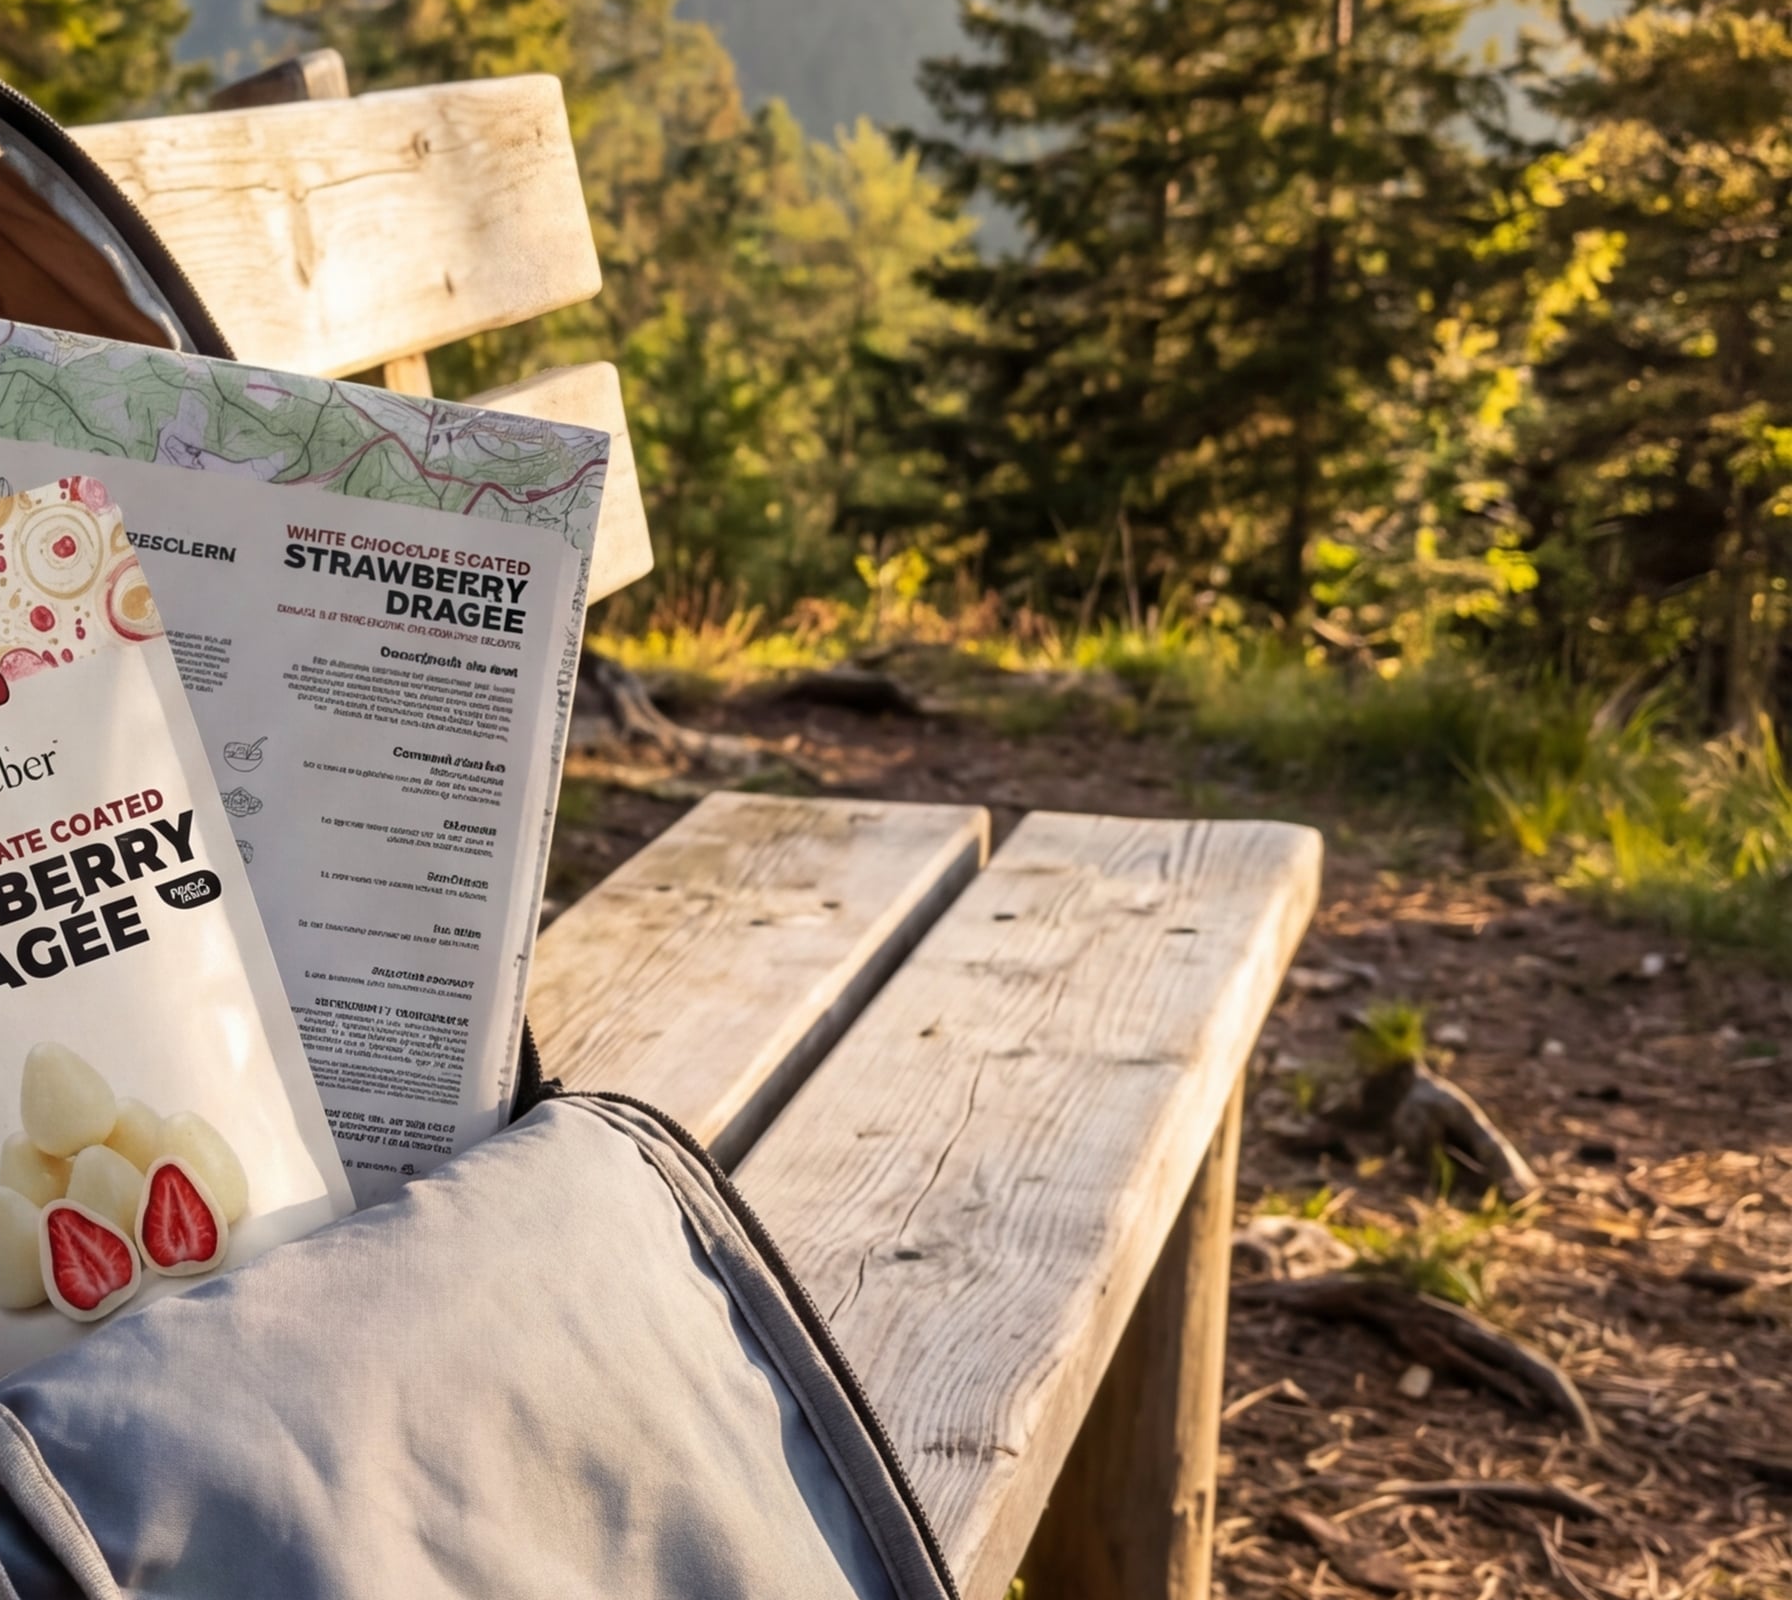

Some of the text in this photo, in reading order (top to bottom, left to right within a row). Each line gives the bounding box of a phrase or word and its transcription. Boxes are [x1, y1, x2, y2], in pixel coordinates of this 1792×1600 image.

[283, 543, 528, 605] STRAWBERRY
[286, 524, 346, 547] WHITE
[454, 551, 531, 576] SCATED
[50, 788, 164, 844] COATED
